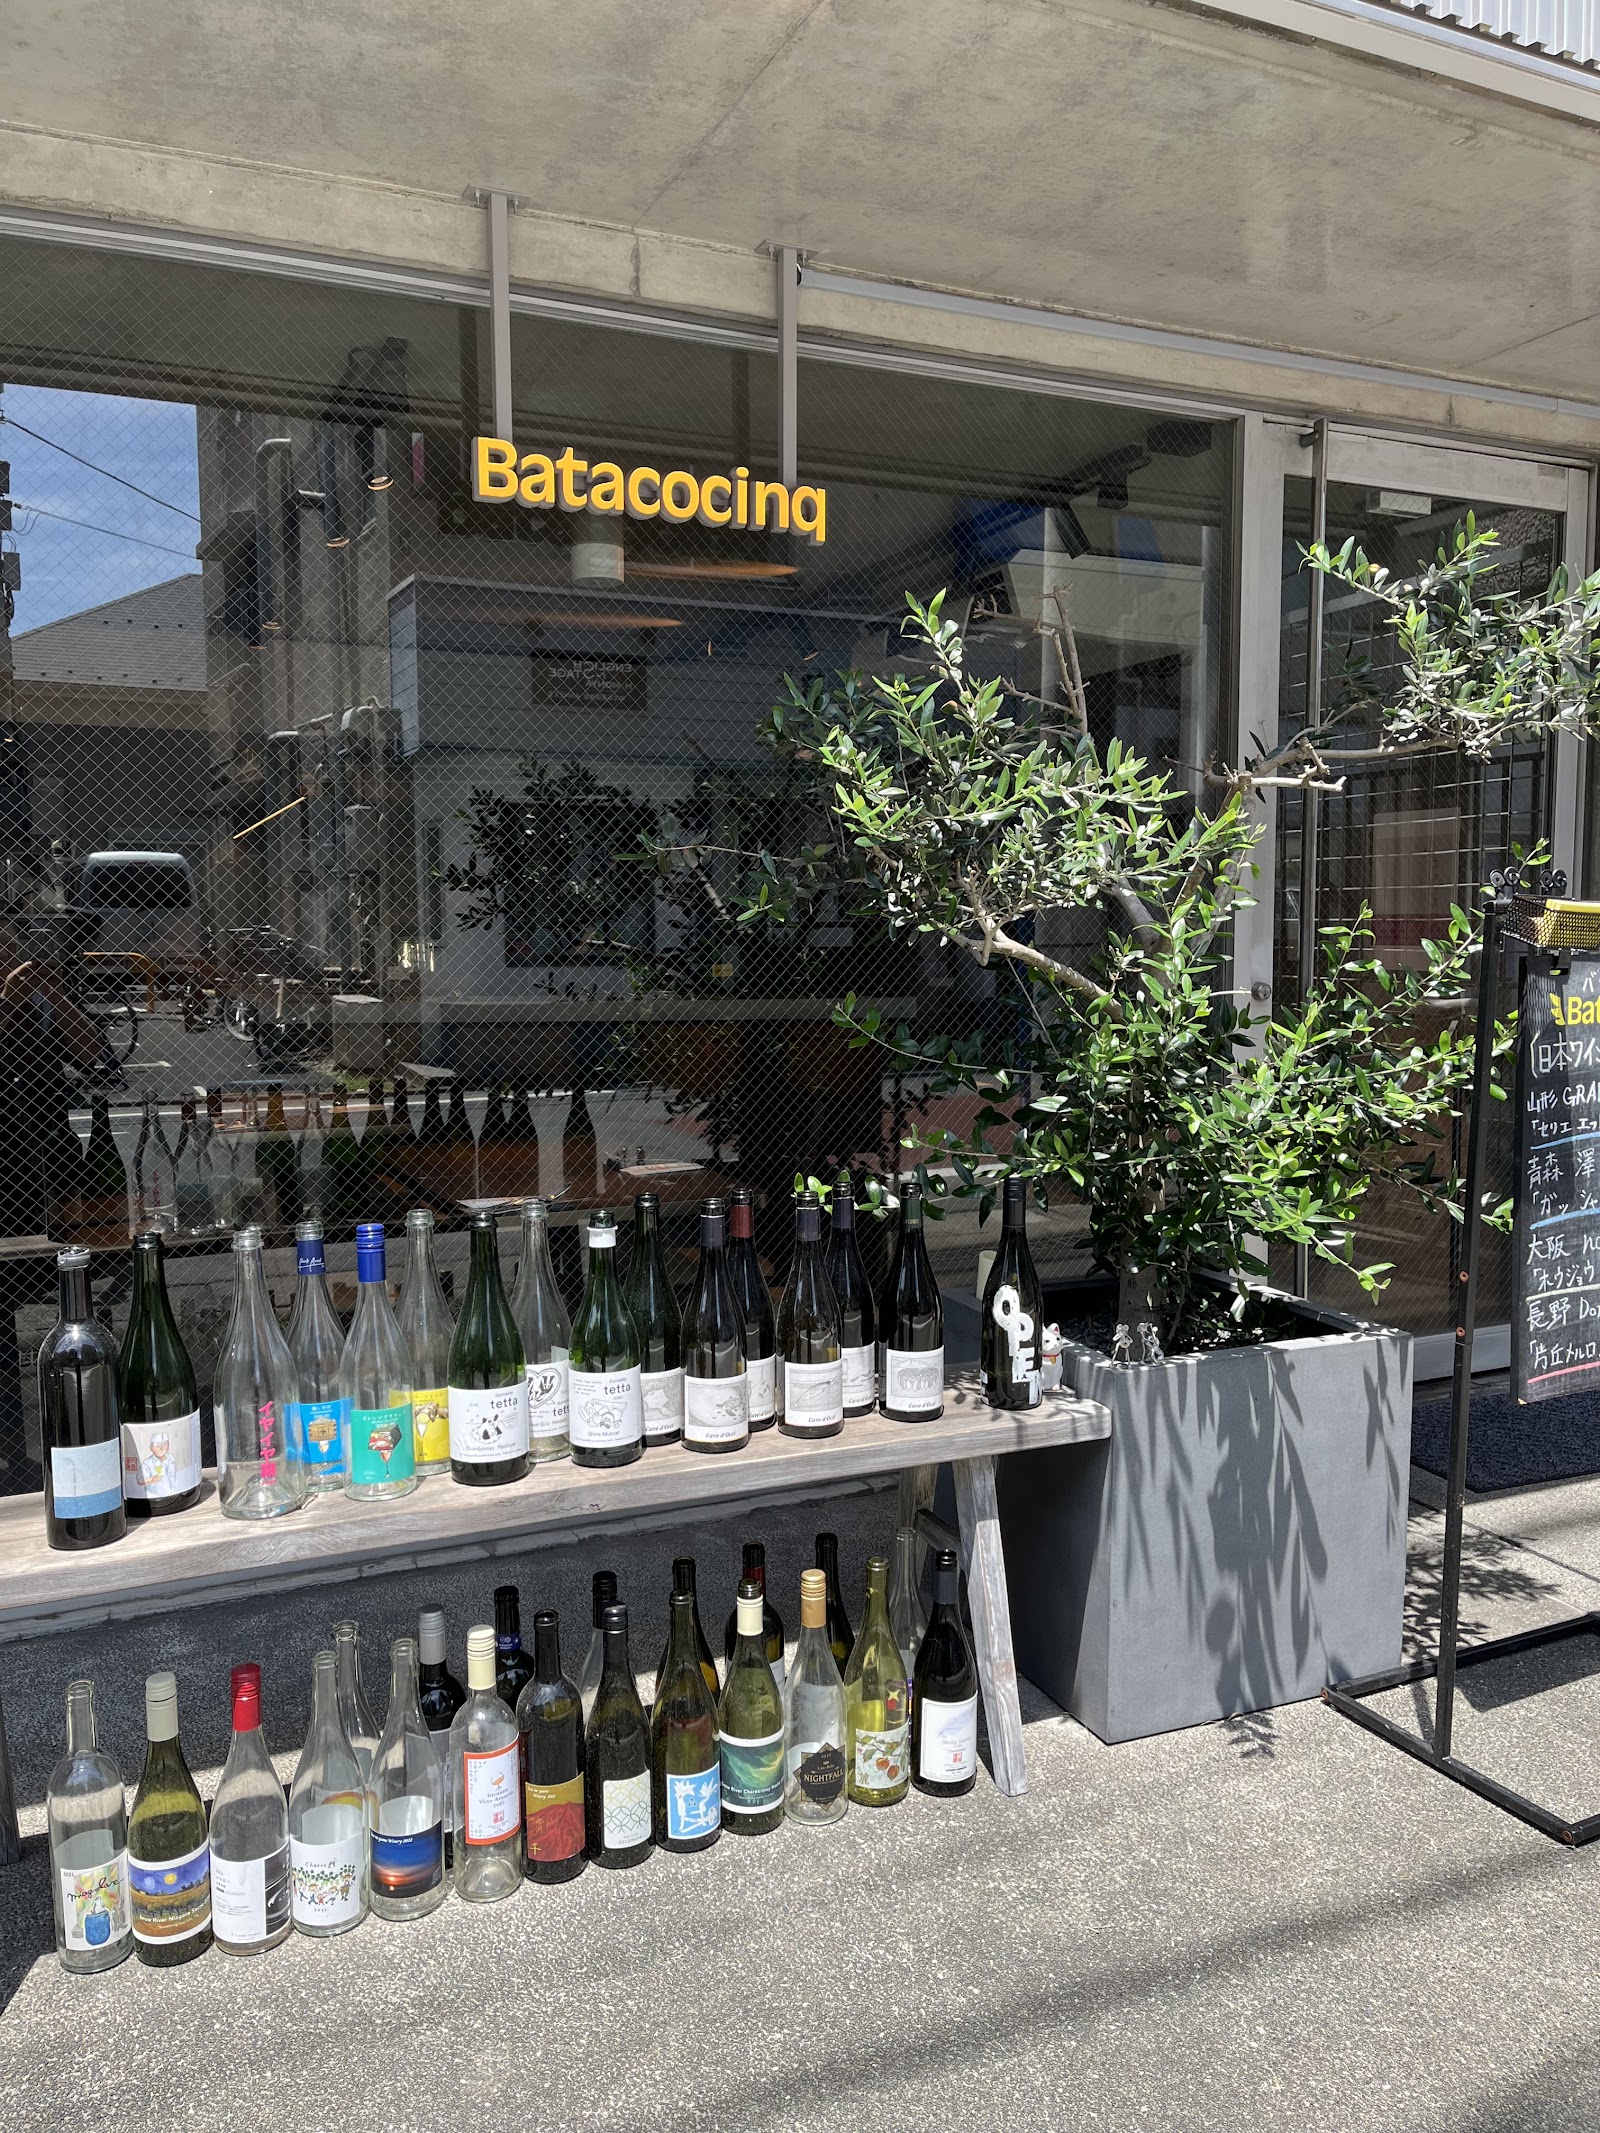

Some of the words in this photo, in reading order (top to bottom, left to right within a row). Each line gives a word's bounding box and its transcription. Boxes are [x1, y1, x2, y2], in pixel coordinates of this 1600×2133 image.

[473, 436, 826, 546] Batacocinq
[1527, 1089, 1558, 1113] 山形
[1527, 1151, 1564, 1190] 青森
[1527, 1233, 1572, 1265] 大阪
[1527, 1297, 1572, 1332] 長野
[490, 1397, 518, 1409] tetta
[604, 1384, 631, 1395] tetta
[803, 1768, 844, 1783] NIGHTFALL
